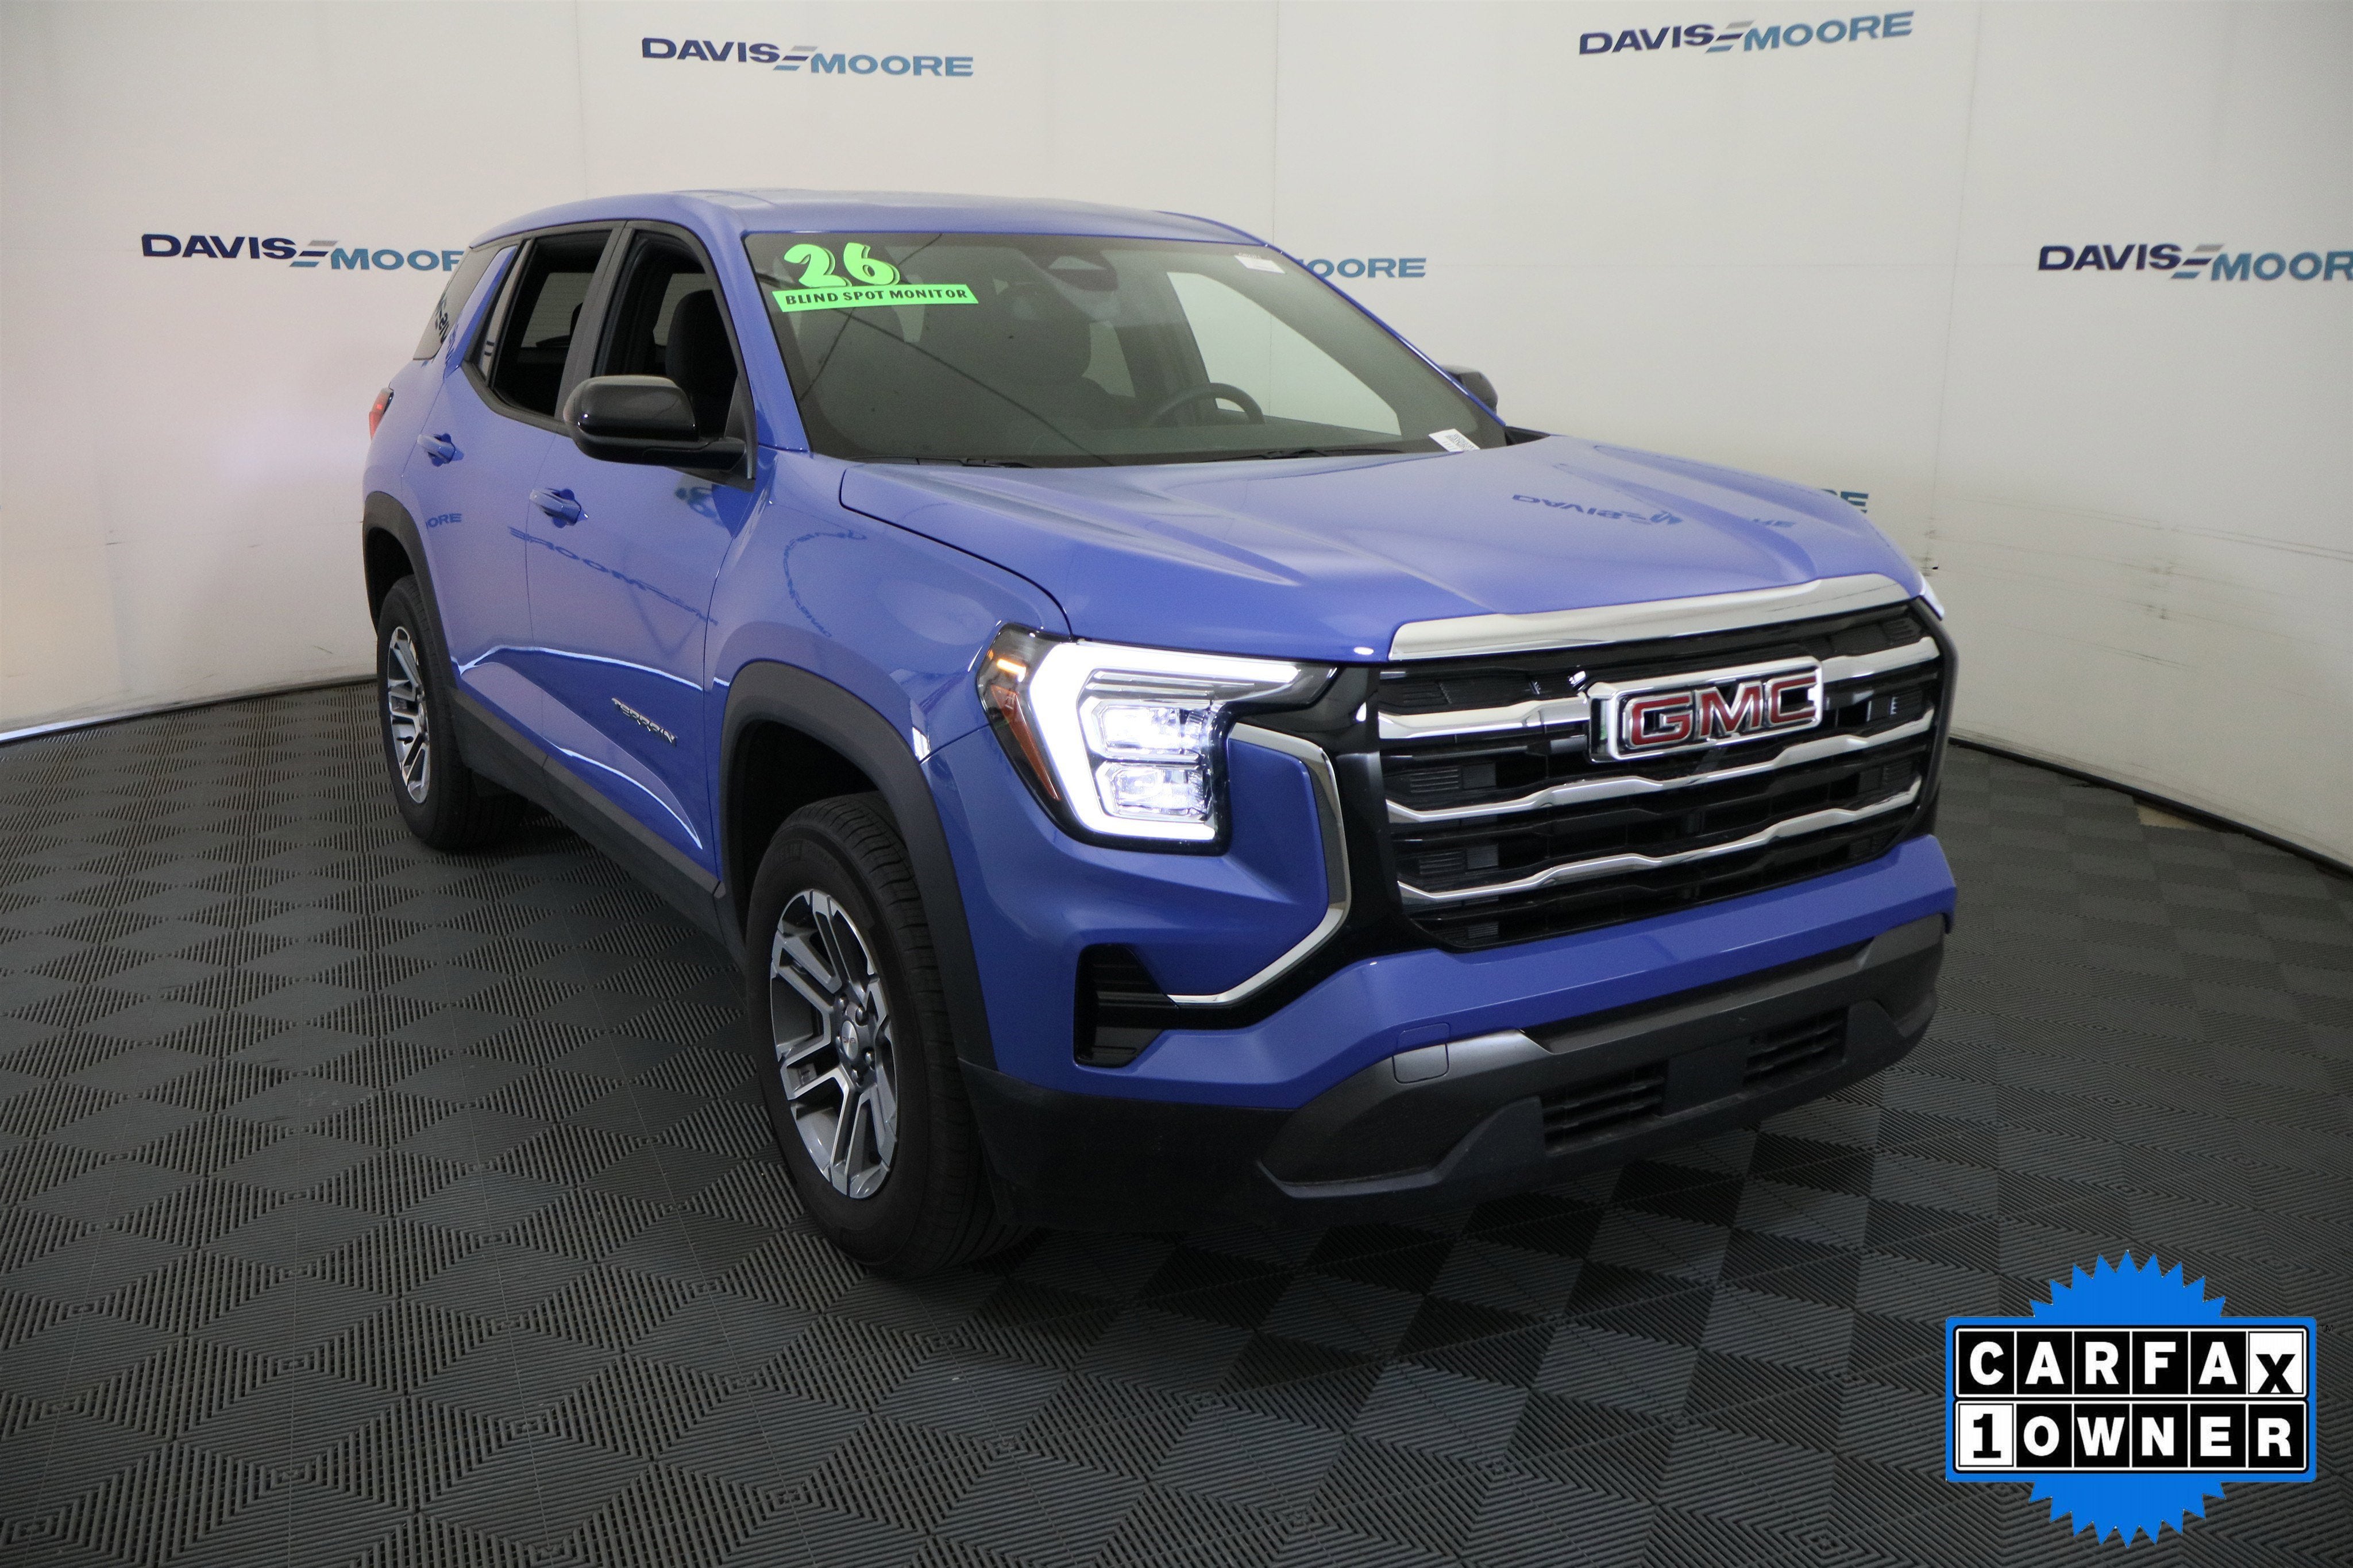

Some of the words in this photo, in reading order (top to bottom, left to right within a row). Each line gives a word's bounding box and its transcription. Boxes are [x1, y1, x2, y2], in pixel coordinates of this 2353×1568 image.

[1579, 24, 1715, 55] DAVIS
[1743, 11, 1914, 52] MOORE
[641, 37, 781, 64] DAVIS
[811, 53, 973, 76] MOORE
[141, 233, 297, 260] DAVIS
[330, 248, 464, 271] MOOR
[784, 242, 900, 288] 26
[1297, 258, 1426, 279] OORE
[2038, 244, 2182, 271] DAVIS
[2211, 250, 2353, 281] MOOR
[785, 293, 839, 305] BLIND
[843, 290, 884, 301] SPOT
[889, 289, 967, 299] MONITOR
[1622, 674, 1818, 749] GMC
